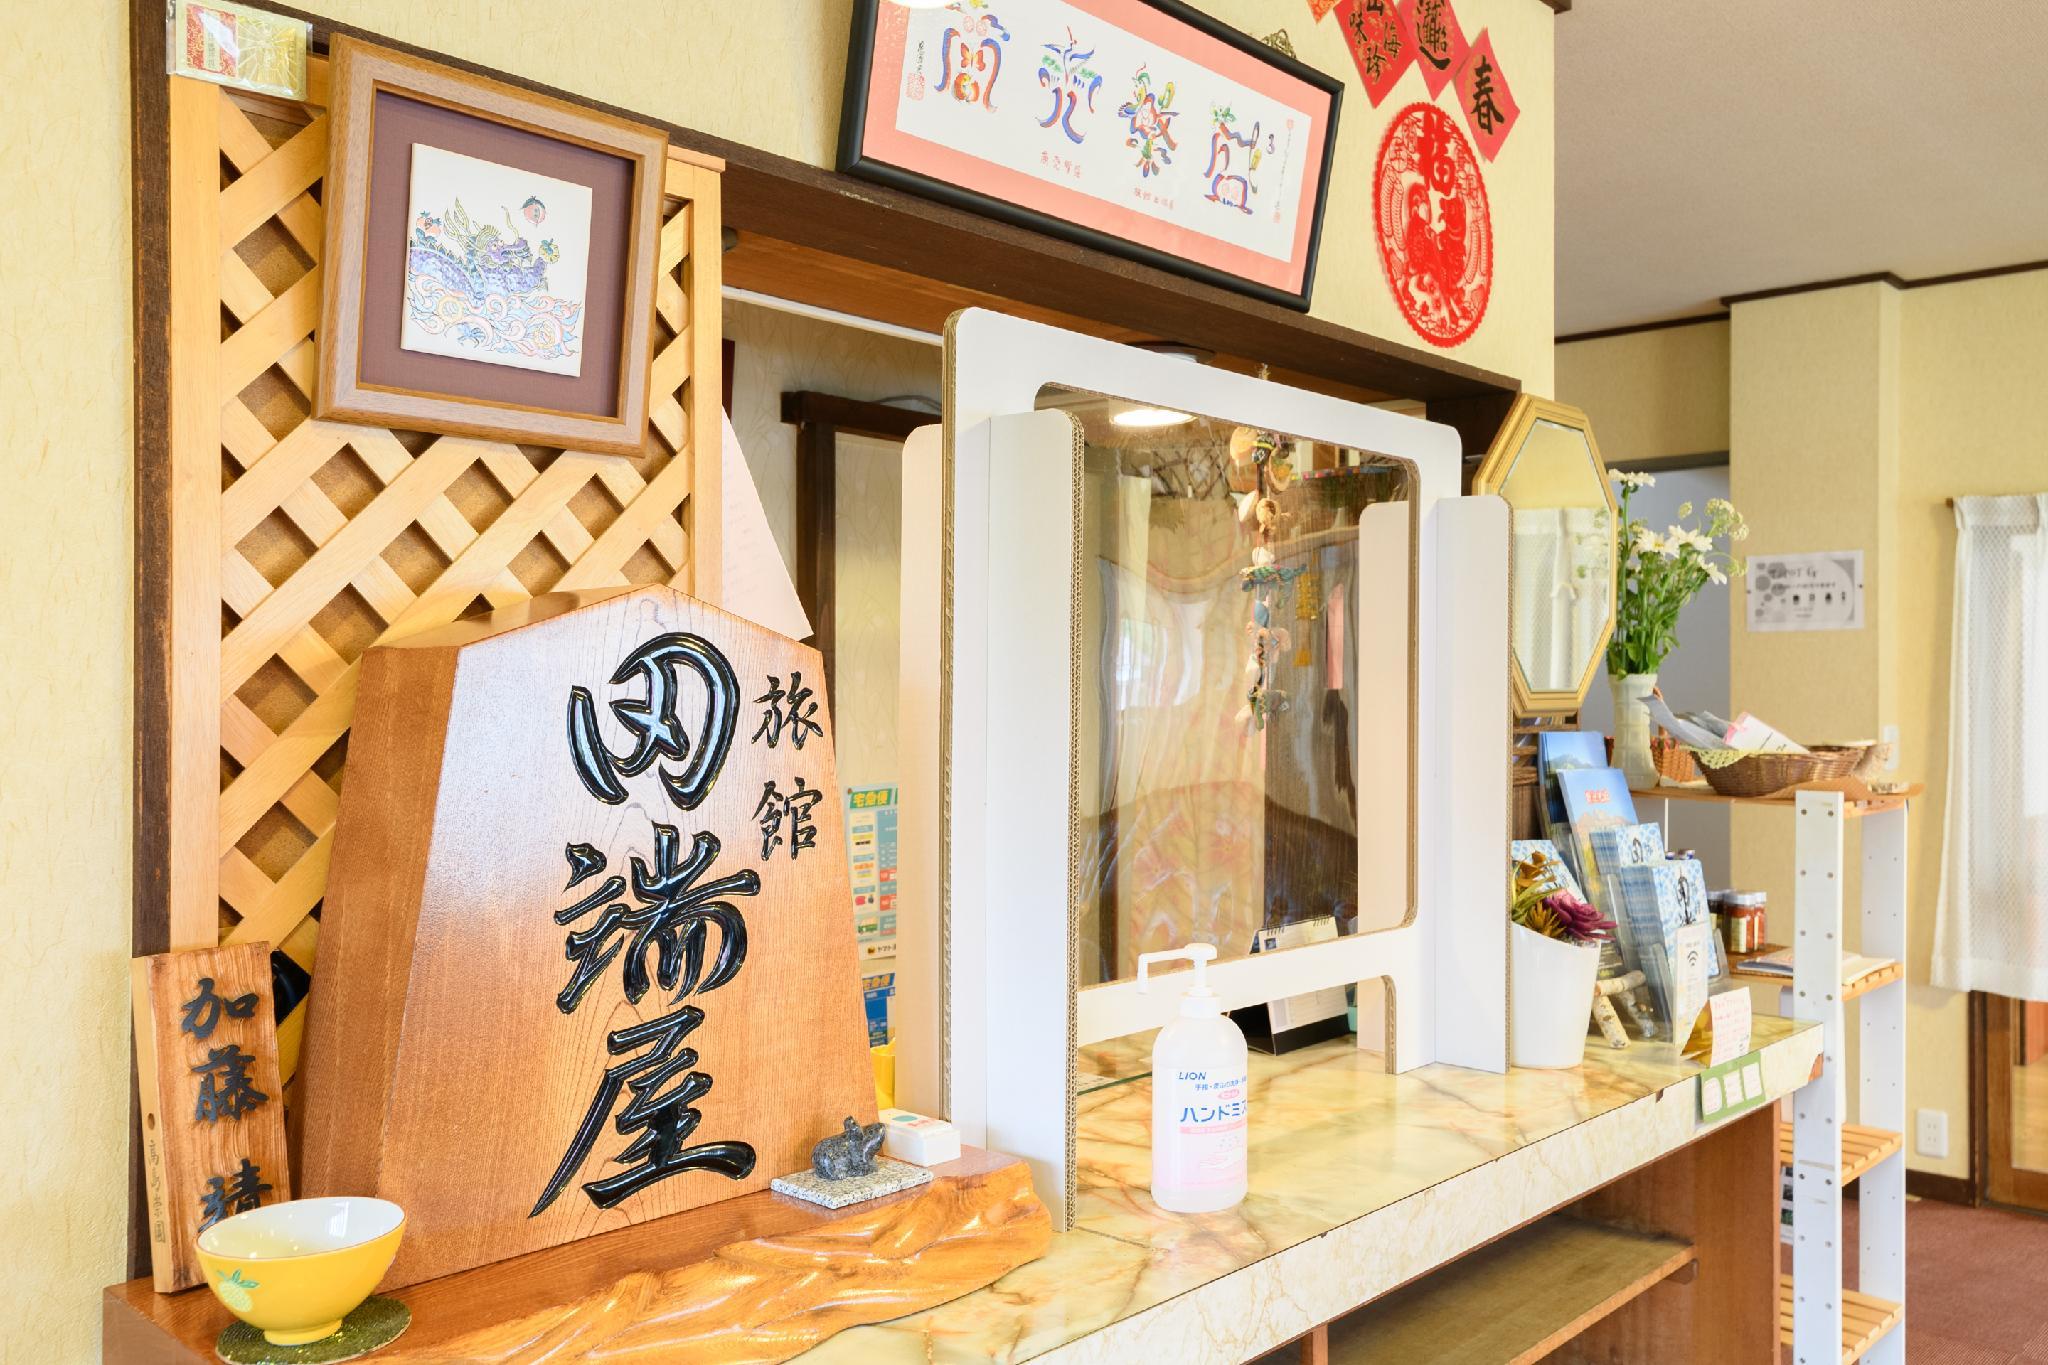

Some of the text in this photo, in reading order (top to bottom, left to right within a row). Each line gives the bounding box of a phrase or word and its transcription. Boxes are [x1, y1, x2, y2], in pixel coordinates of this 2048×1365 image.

[1470, 54, 1505, 136] 春
[751, 671, 824, 862] 旅館
[852, 790, 889, 809] 宅急便
[180, 976, 269, 1124] 加藤
[1178, 1071, 1207, 1081] LION
